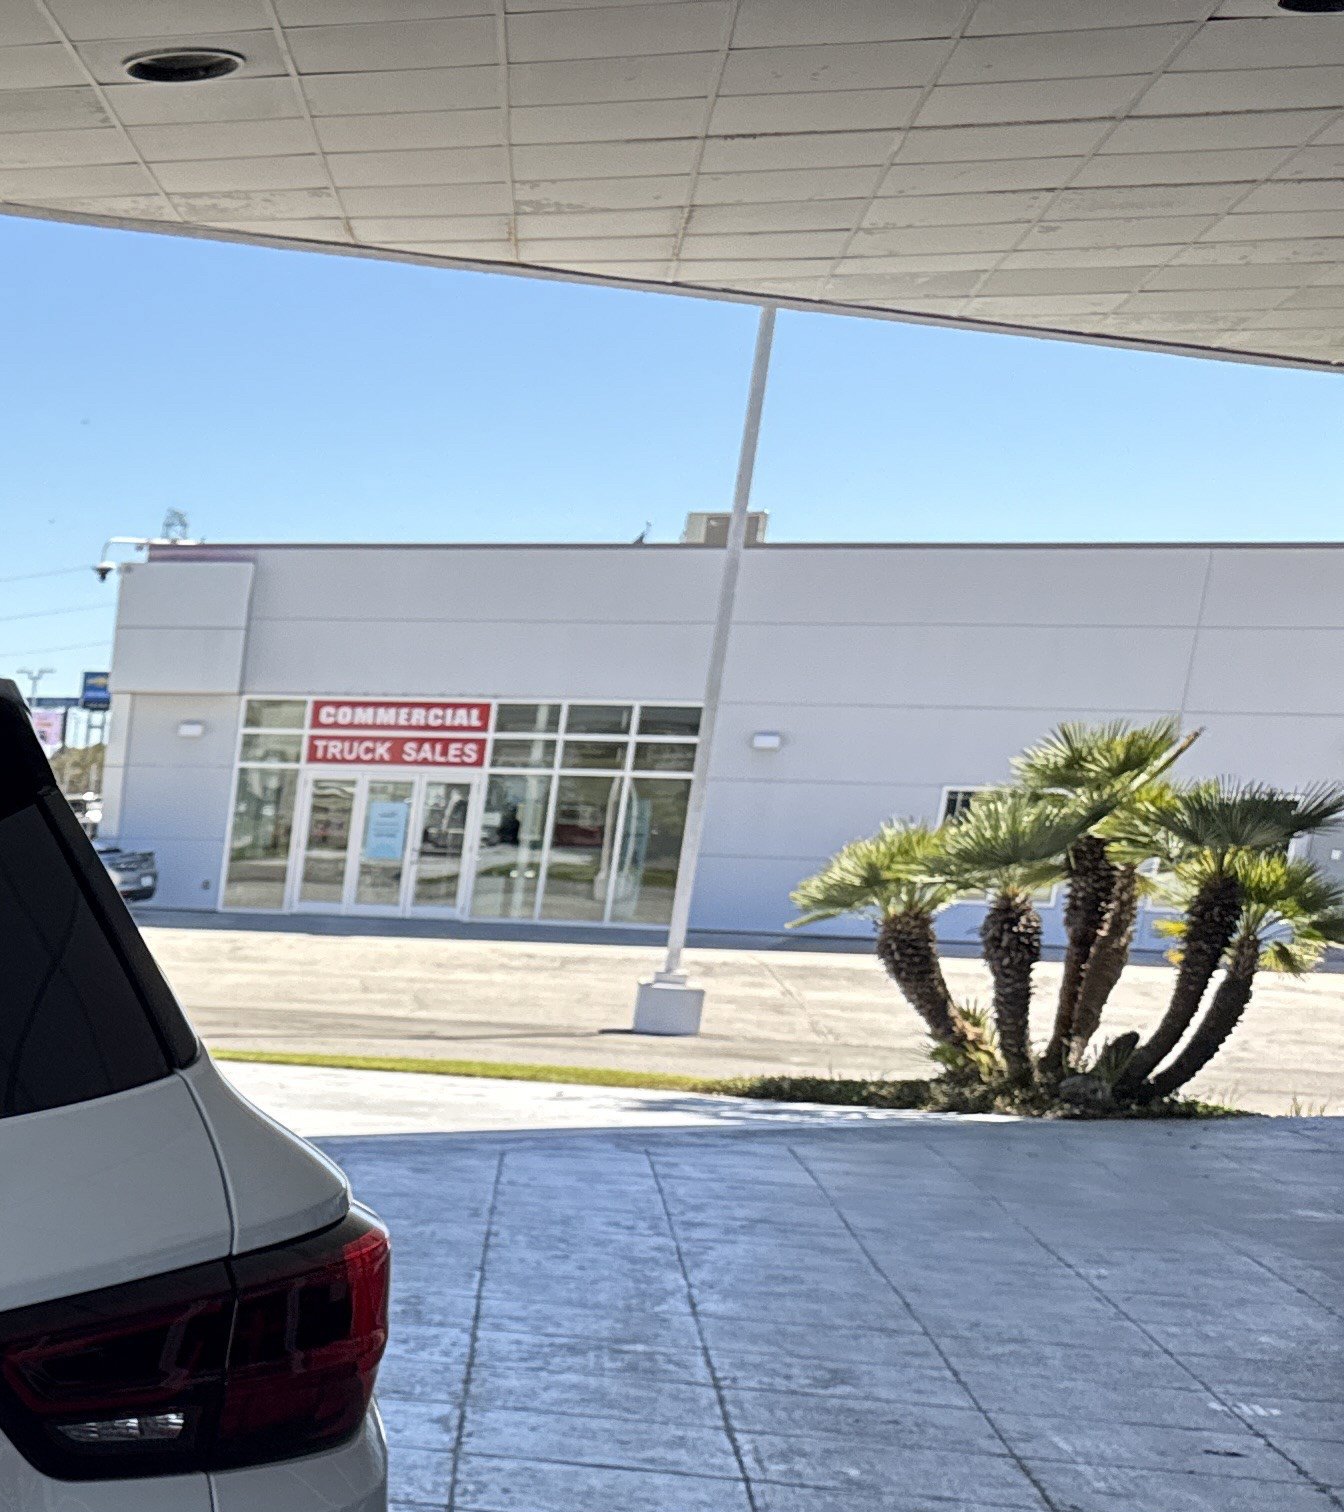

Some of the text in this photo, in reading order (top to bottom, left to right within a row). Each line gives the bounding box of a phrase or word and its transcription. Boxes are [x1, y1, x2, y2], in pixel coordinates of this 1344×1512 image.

[318, 705, 483, 727] COMMERCIAL
[313, 739, 479, 764] TRUCK SALES
